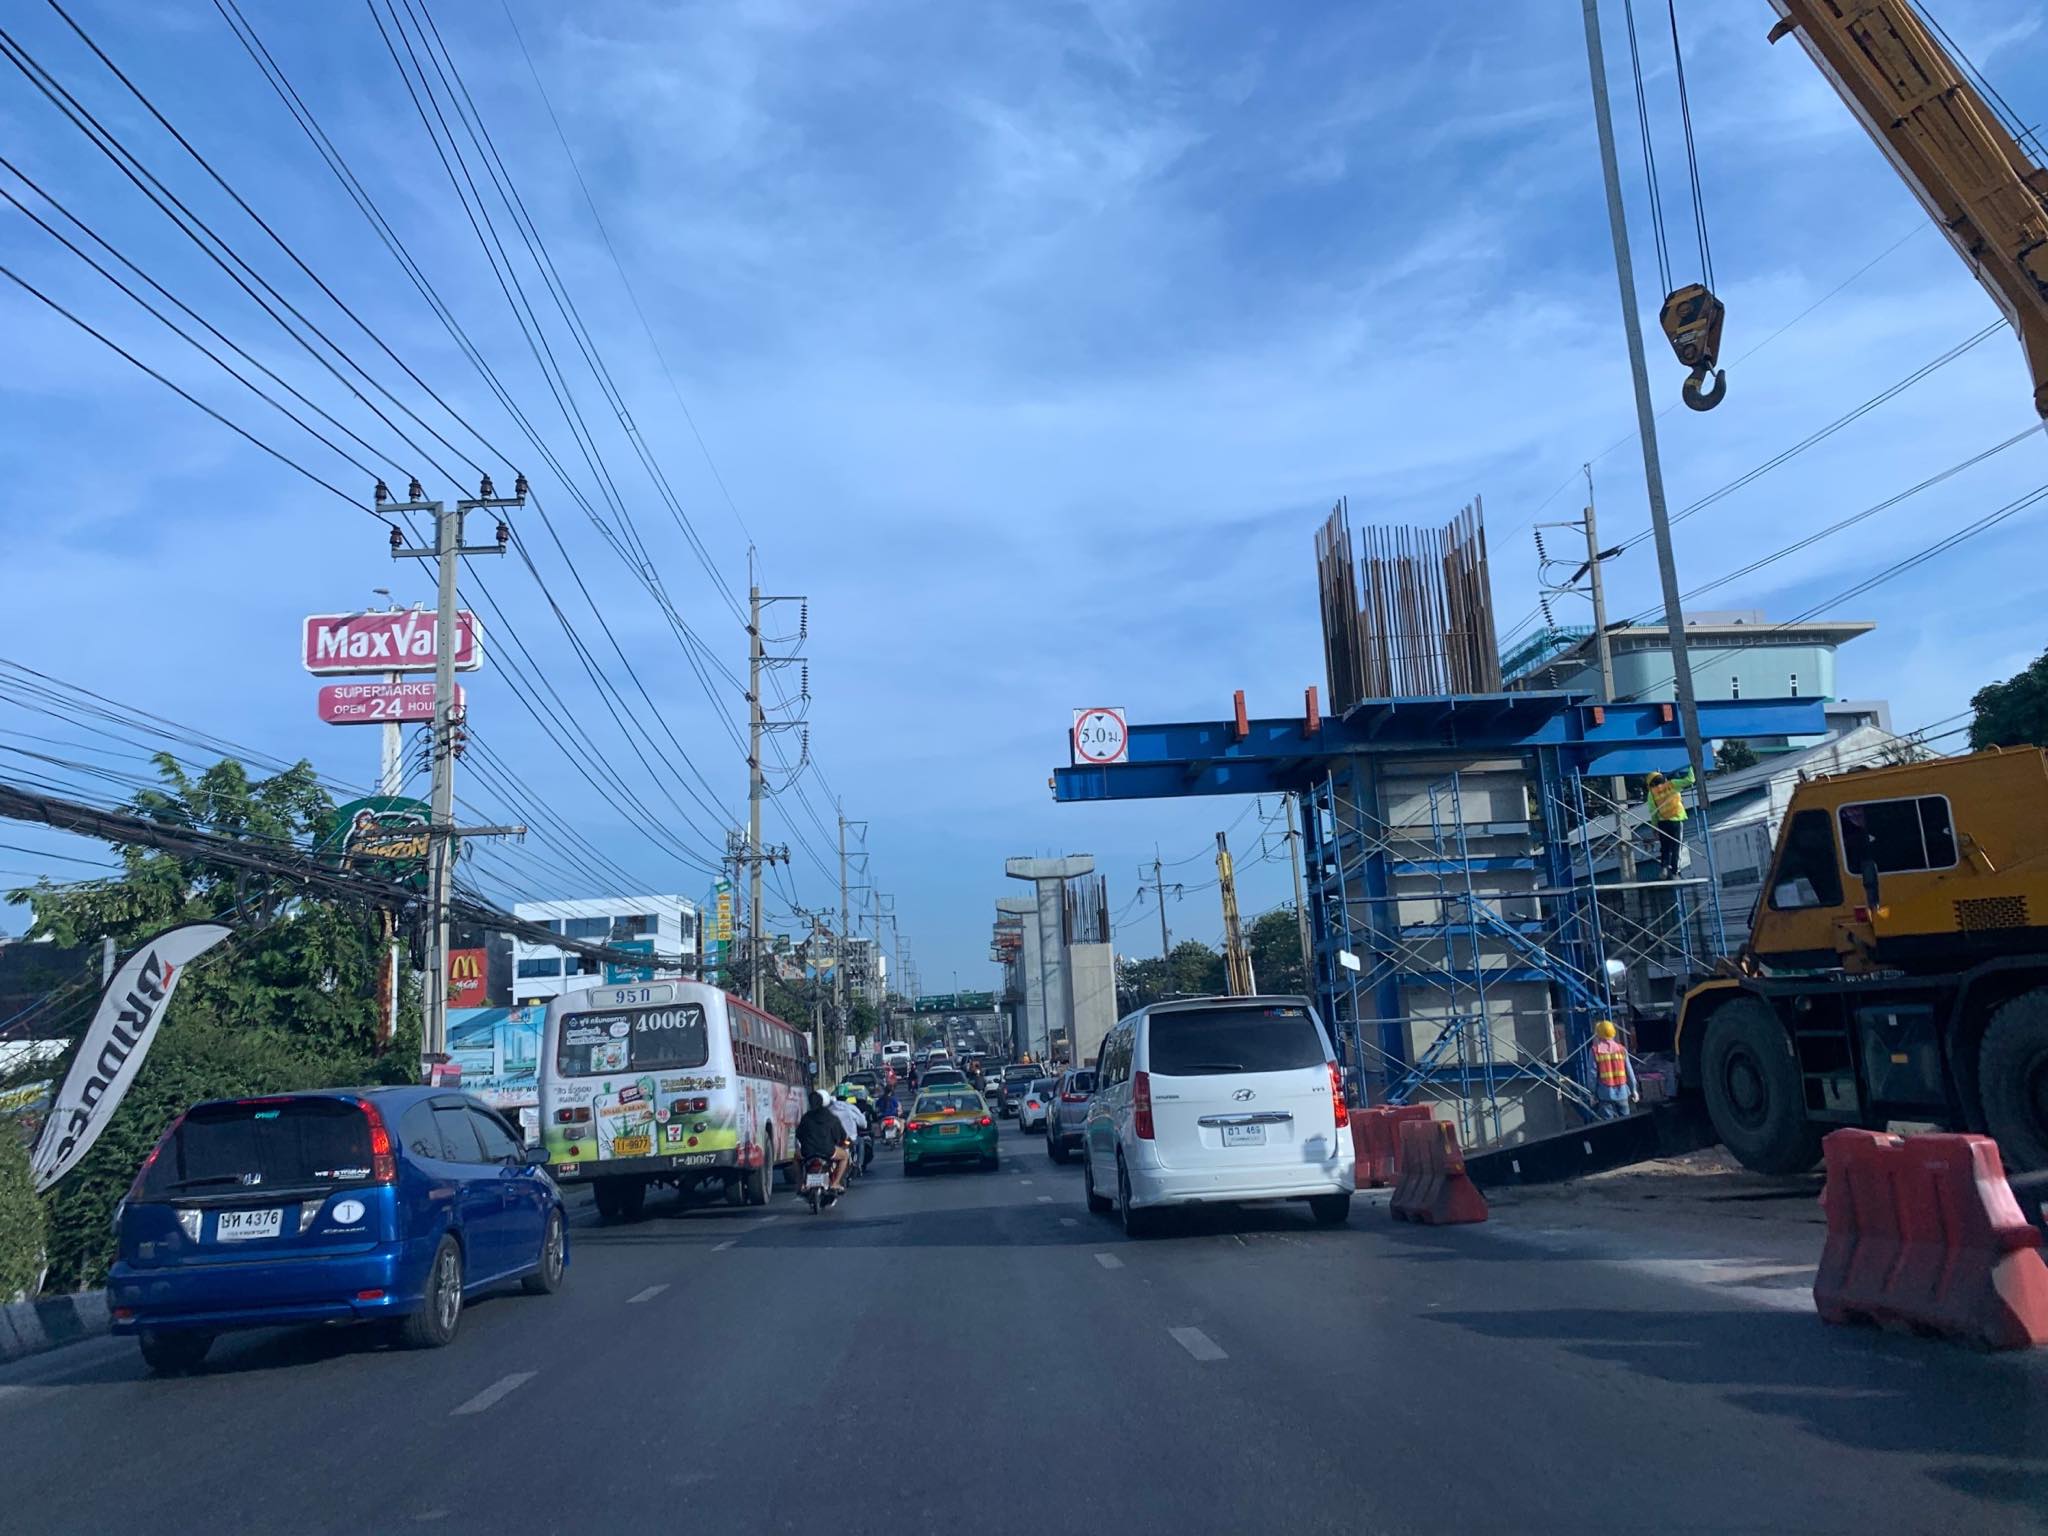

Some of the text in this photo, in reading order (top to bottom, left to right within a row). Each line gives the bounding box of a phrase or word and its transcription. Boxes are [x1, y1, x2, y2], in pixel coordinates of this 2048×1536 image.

[334, 698, 437, 718] OPEN 24 HOU
[1082, 728, 1106, 743] 5.0
[636, 1009, 700, 1033] 40067
[672, 1154, 717, 1167] 1-40067
[245, 1211, 279, 1226] 4376
